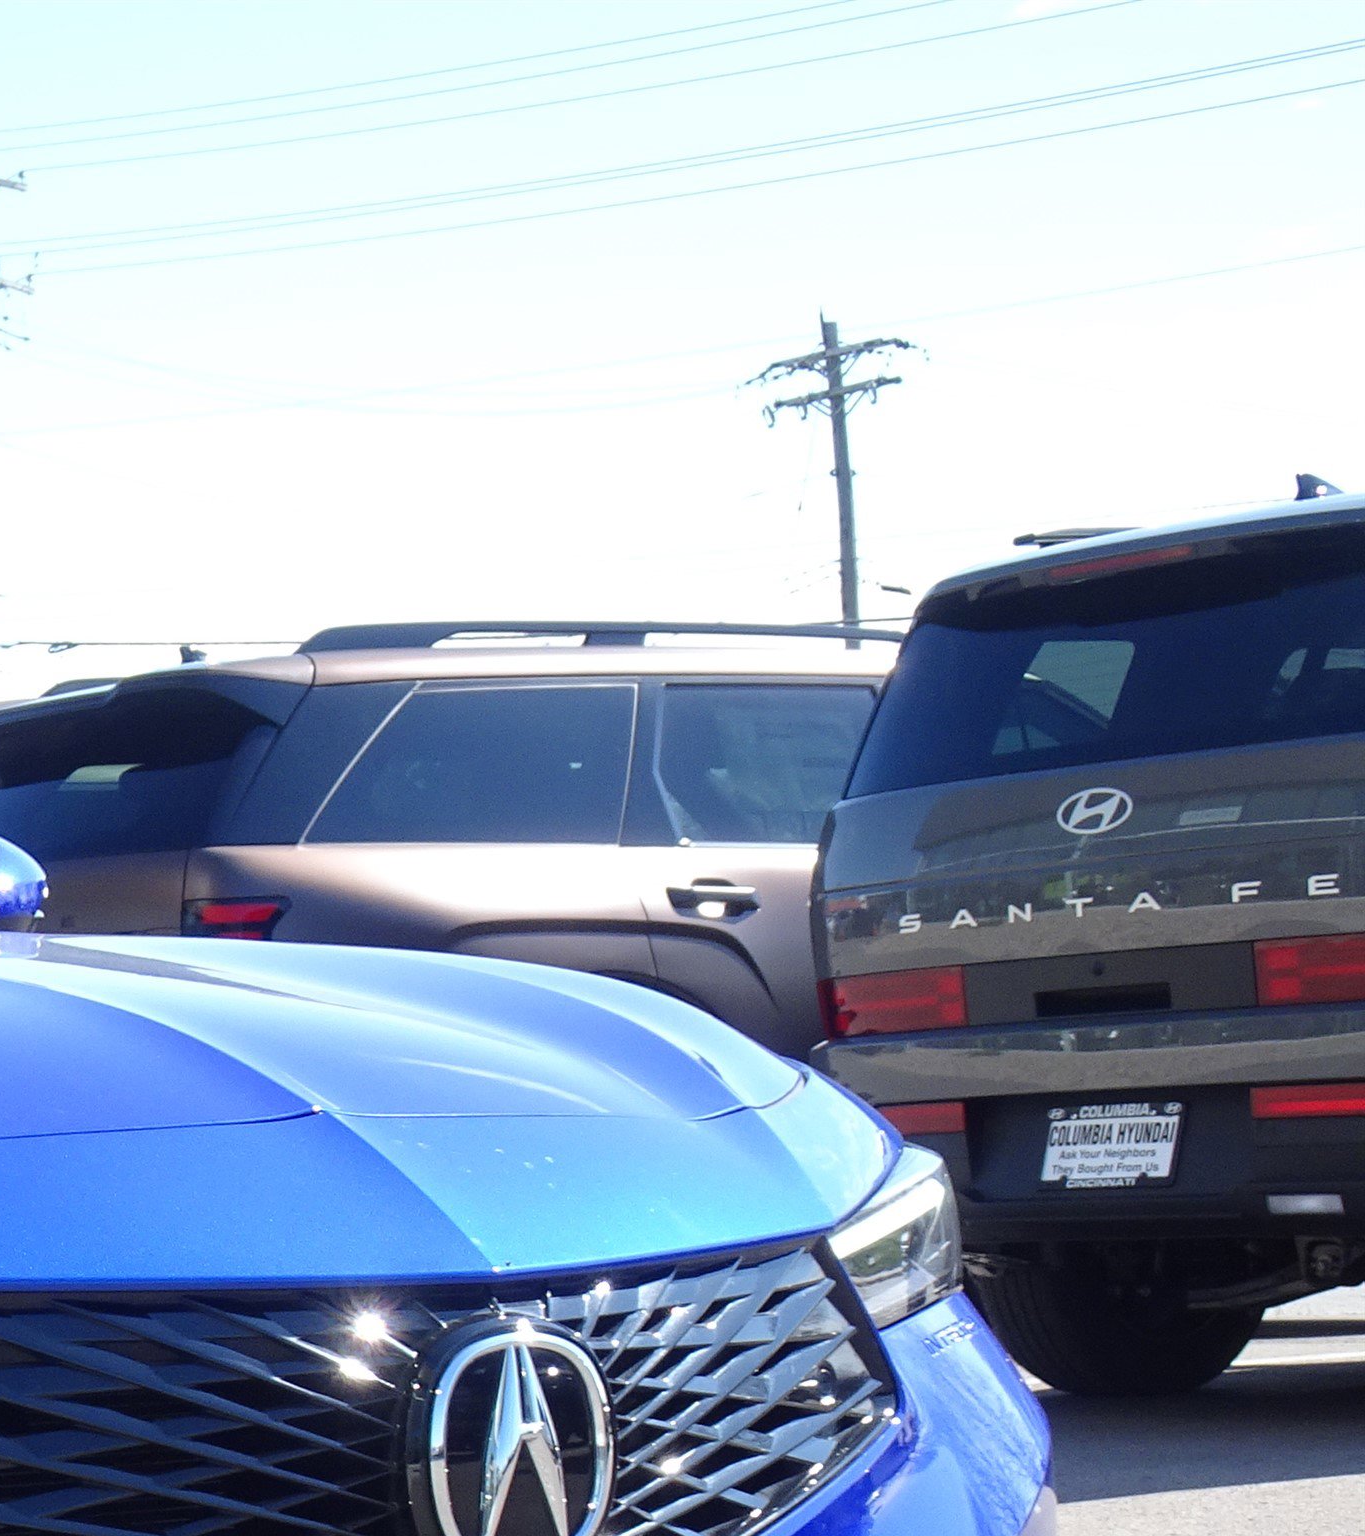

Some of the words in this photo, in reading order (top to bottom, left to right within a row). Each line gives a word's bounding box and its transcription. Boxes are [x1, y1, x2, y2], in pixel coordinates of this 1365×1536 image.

[897, 891, 1162, 934] SANTA
[1230, 872, 1342, 904] FE
[1079, 1102, 1150, 1119] COLUMBIA
[1049, 1123, 1112, 1147] COLUMBIA
[1116, 1121, 1176, 1145] HYUNDAI
[1059, 1150, 1077, 1160] Ask
[1079, 1149, 1101, 1159] Your
[1103, 1148, 1157, 1160] Neighbors
[1052, 1164, 1074, 1177] They
[1077, 1163, 1114, 1176] Bought
[1116, 1162, 1142, 1172] From
[1145, 1161, 1159, 1171] Us
[1065, 1178, 1137, 1188] CINCINNATI
